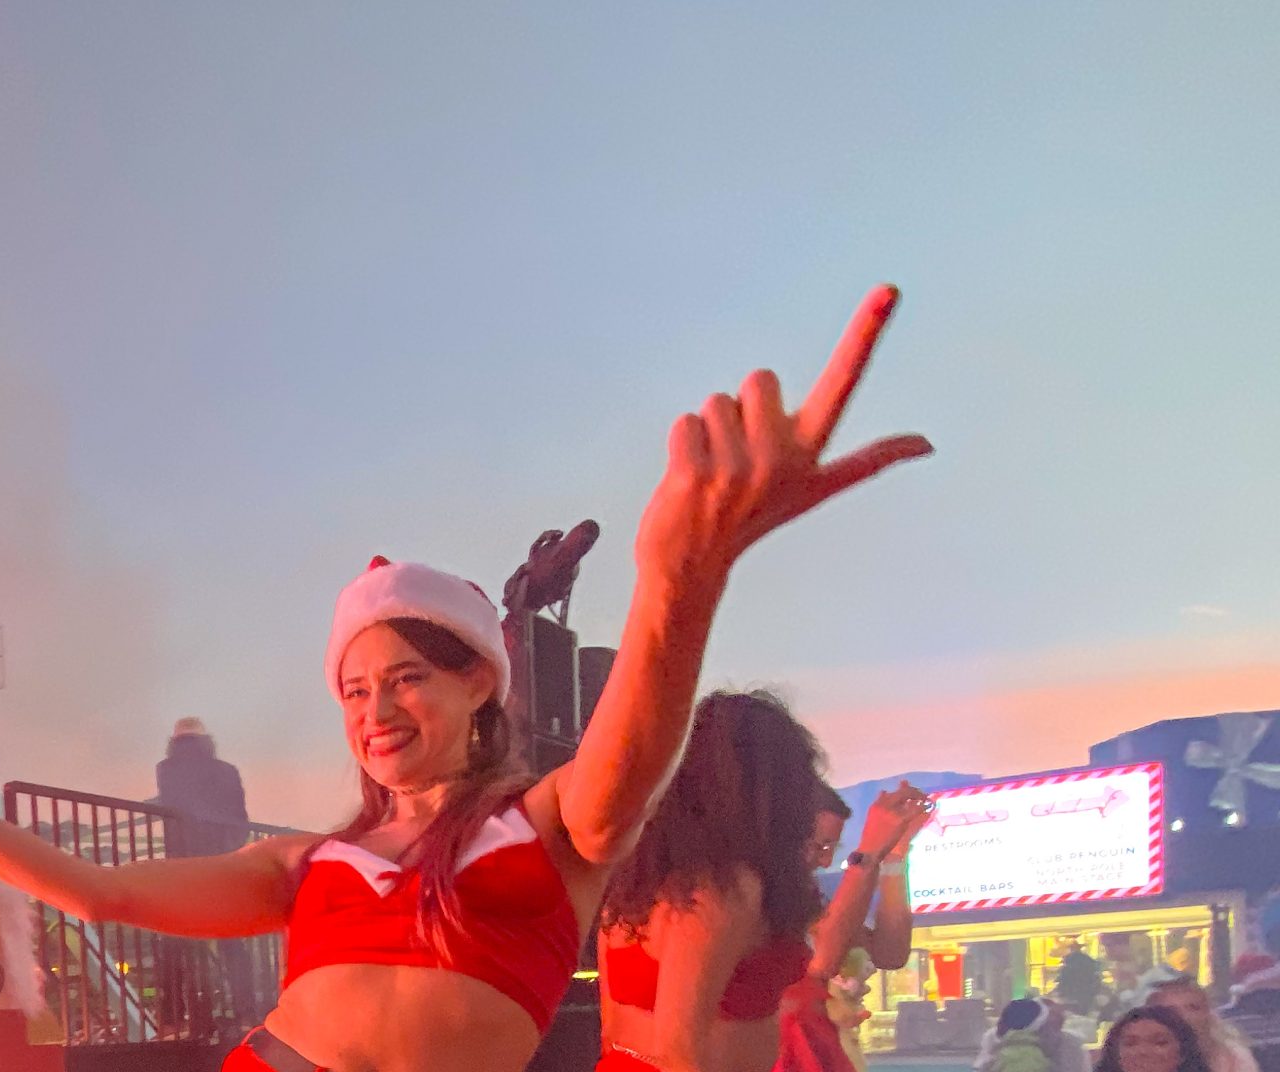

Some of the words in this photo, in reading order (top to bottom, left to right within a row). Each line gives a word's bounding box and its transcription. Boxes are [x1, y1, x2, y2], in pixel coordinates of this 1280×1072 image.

[924, 837, 1002, 853] RESTROOMS
[1068, 847, 1136, 860] PENGUIN
[913, 885, 974, 899] COCKTAIL
[980, 881, 1015, 893] BARS
